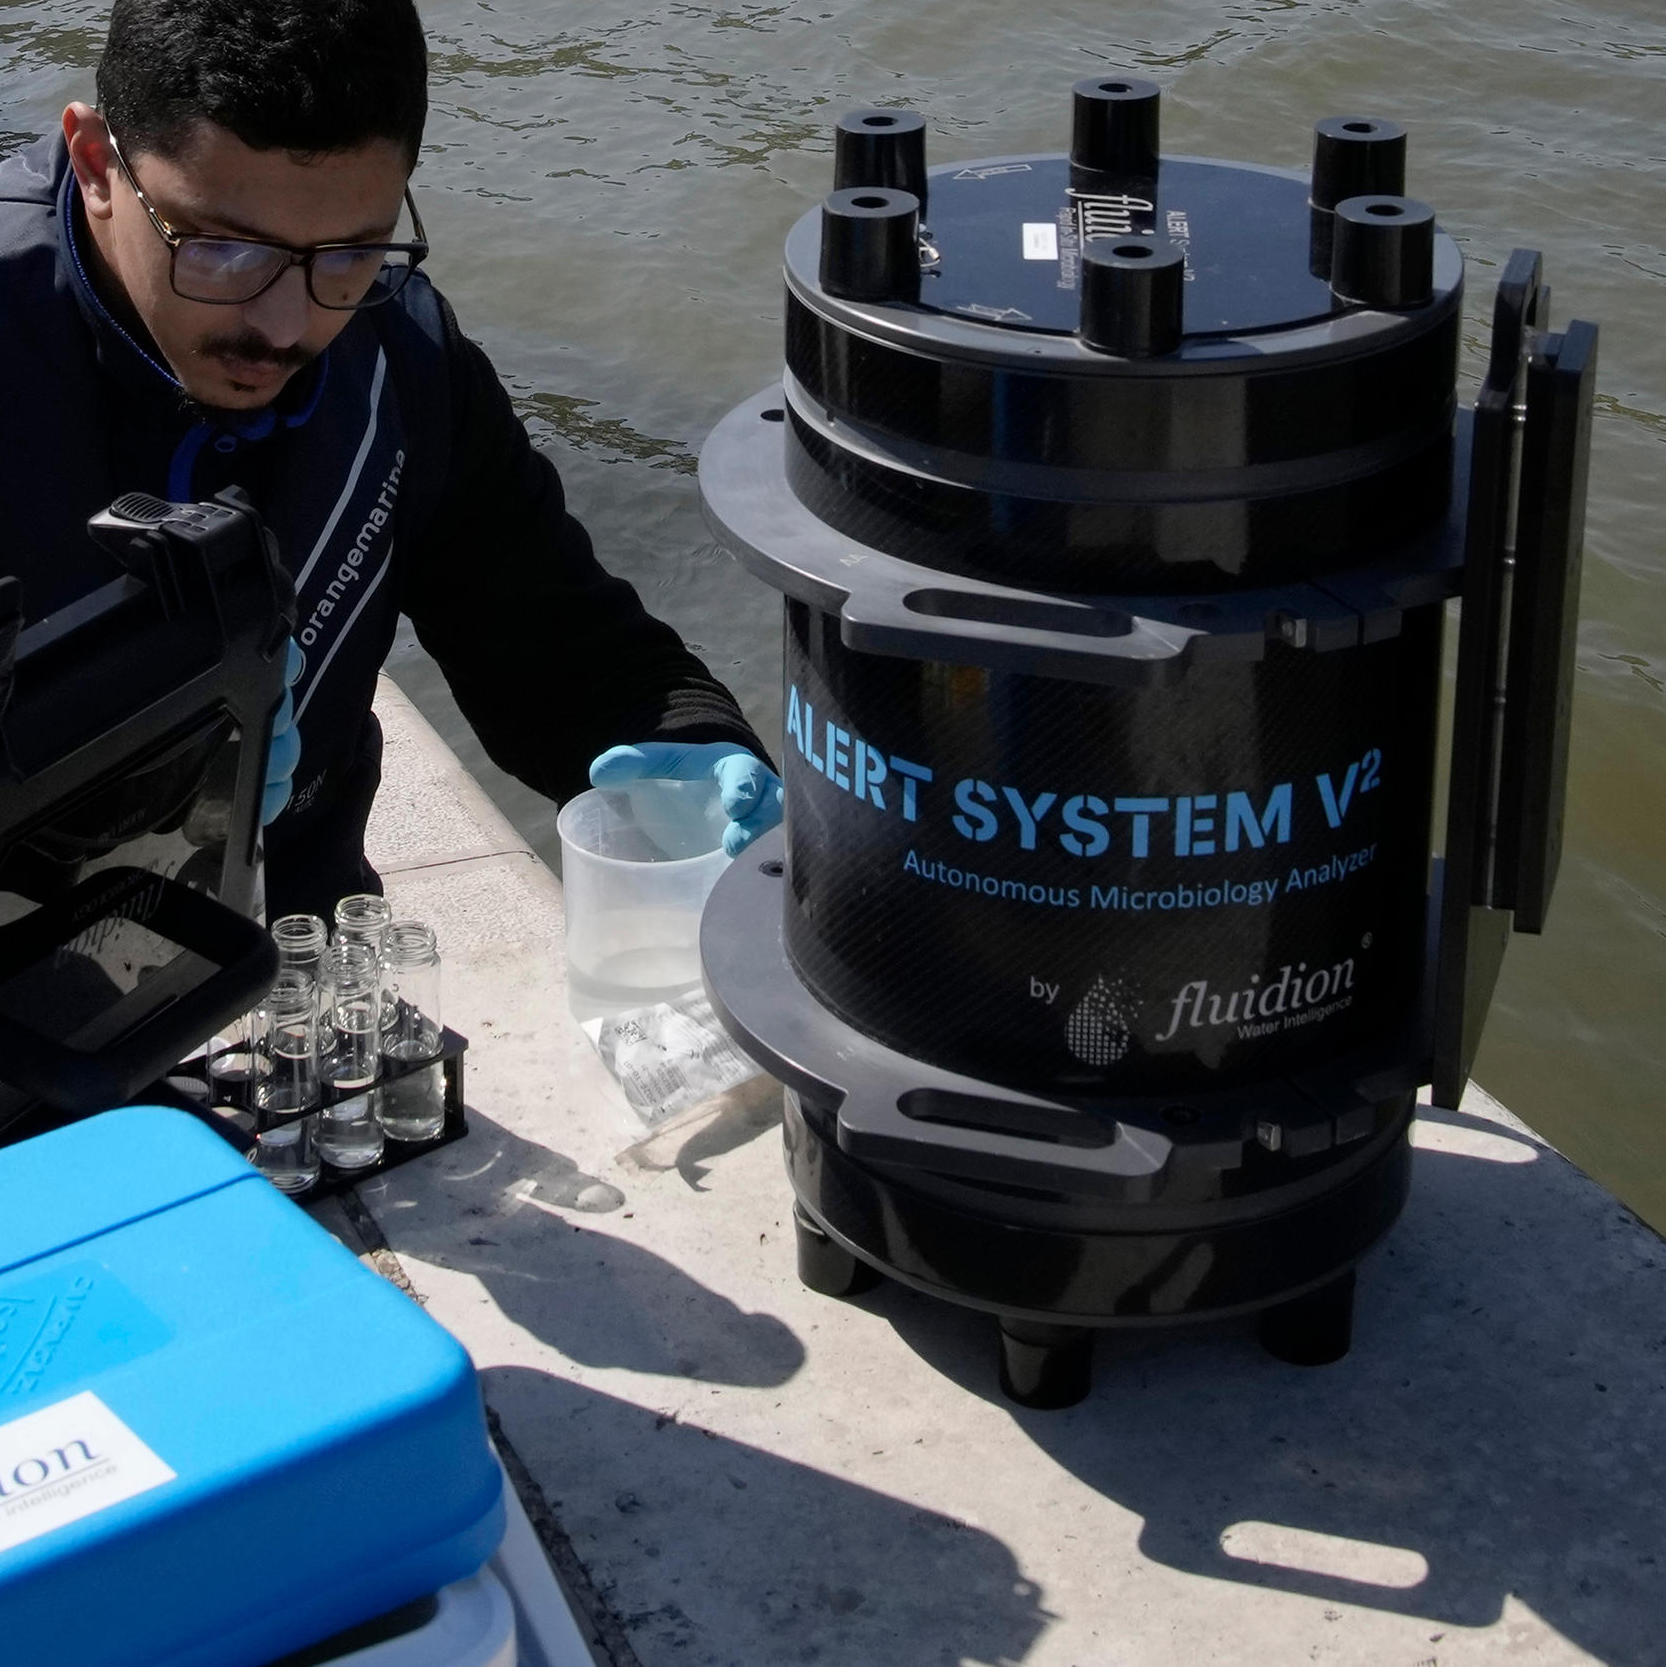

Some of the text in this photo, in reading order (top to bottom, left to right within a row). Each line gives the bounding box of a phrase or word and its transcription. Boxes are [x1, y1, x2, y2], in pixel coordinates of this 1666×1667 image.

[1165, 209, 1190, 240] ALERT
[300, 449, 406, 646] orangemarine
[787, 684, 932, 822] ALERT
[953, 778, 1293, 857] SYSTEM
[904, 842, 1378, 910] Autonomous Microbiology Analyzer
[1029, 958, 1355, 1042] by fluidion
[1237, 995, 1353, 1040] Water Intelligence
[3, 1463, 118, 1519] intelligence
